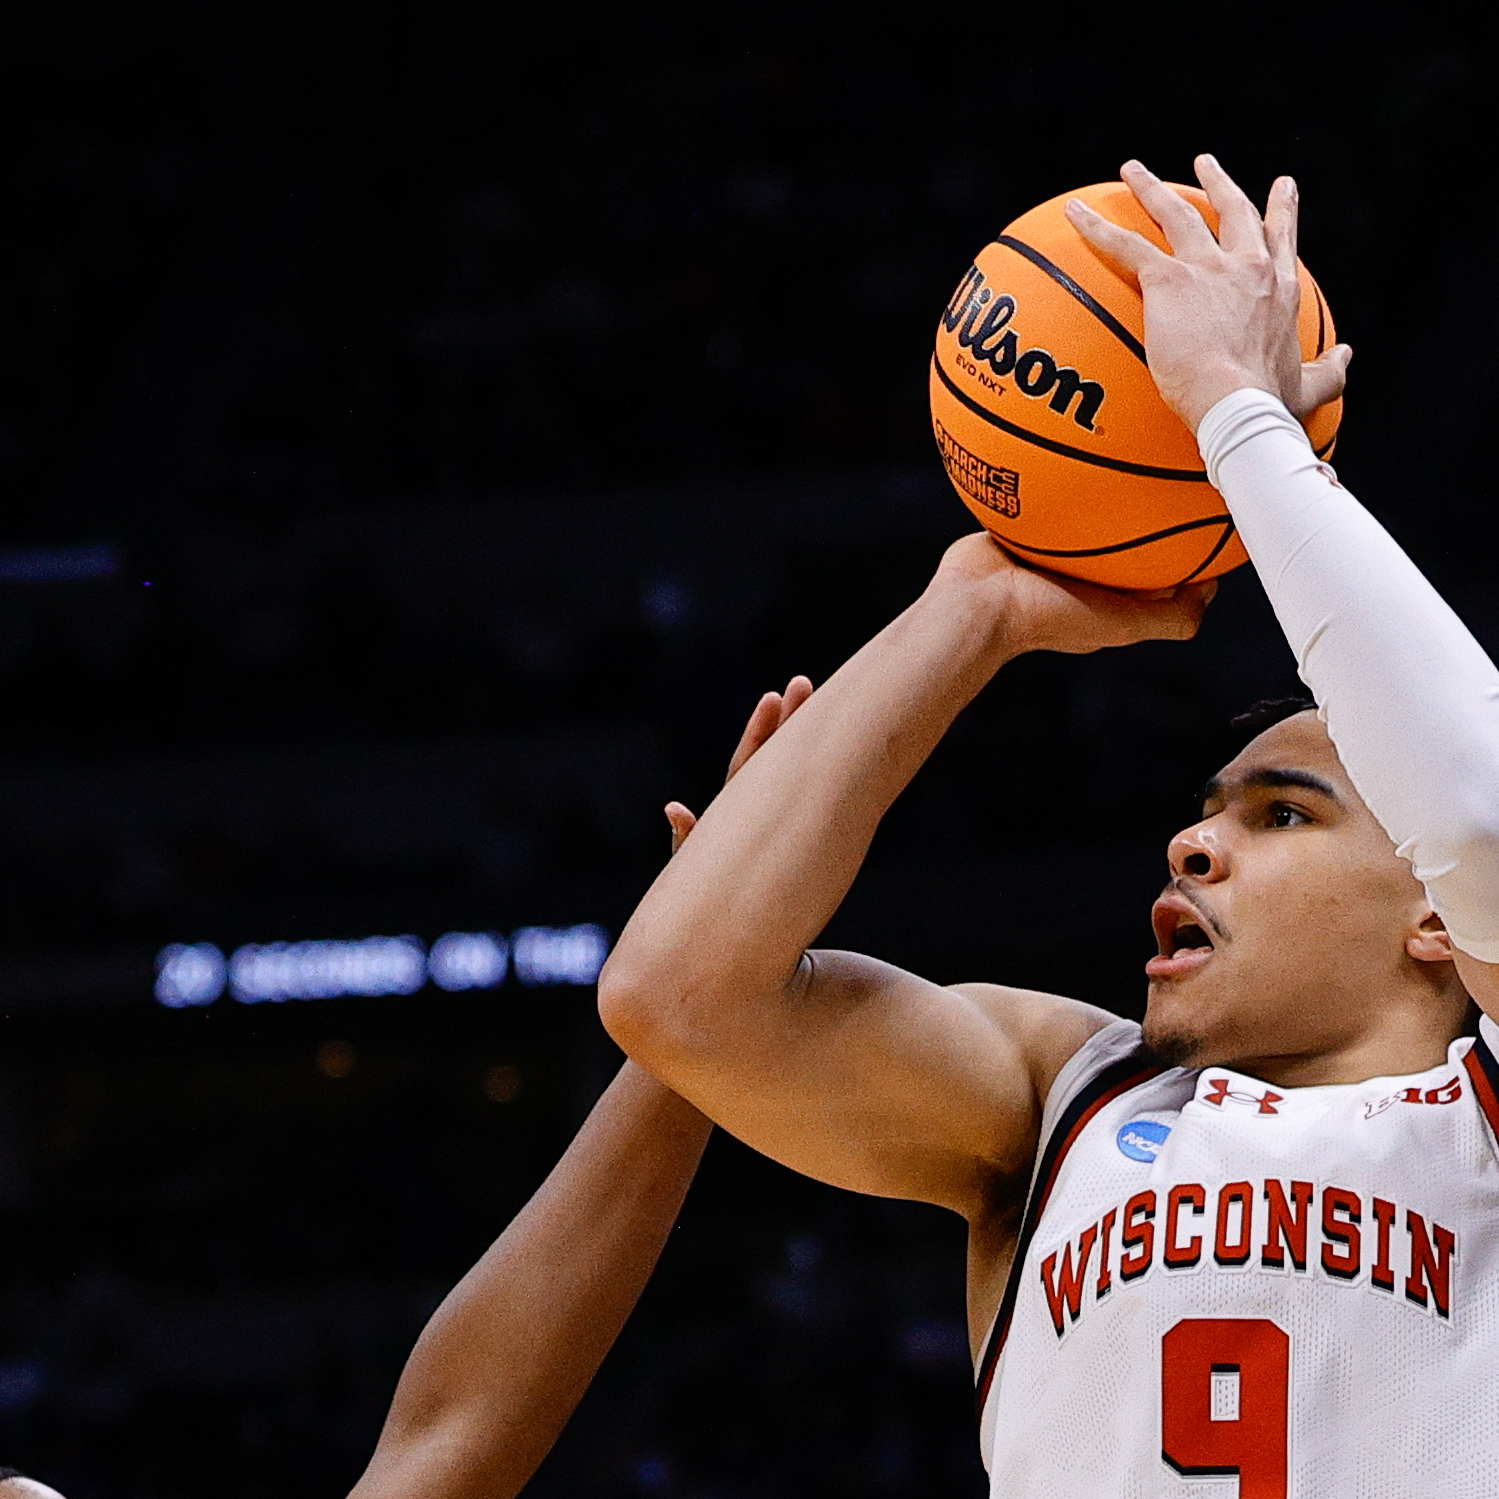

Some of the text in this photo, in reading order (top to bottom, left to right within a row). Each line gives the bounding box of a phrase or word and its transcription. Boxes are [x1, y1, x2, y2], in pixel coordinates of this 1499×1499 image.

[942, 264, 1105, 432] Wilson
[955, 353, 1007, 397] EVO NXT
[943, 432, 988, 483] MARCH
[949, 458, 1018, 516] MADNESS
[1041, 1179, 1456, 1338] WISCONSIN
